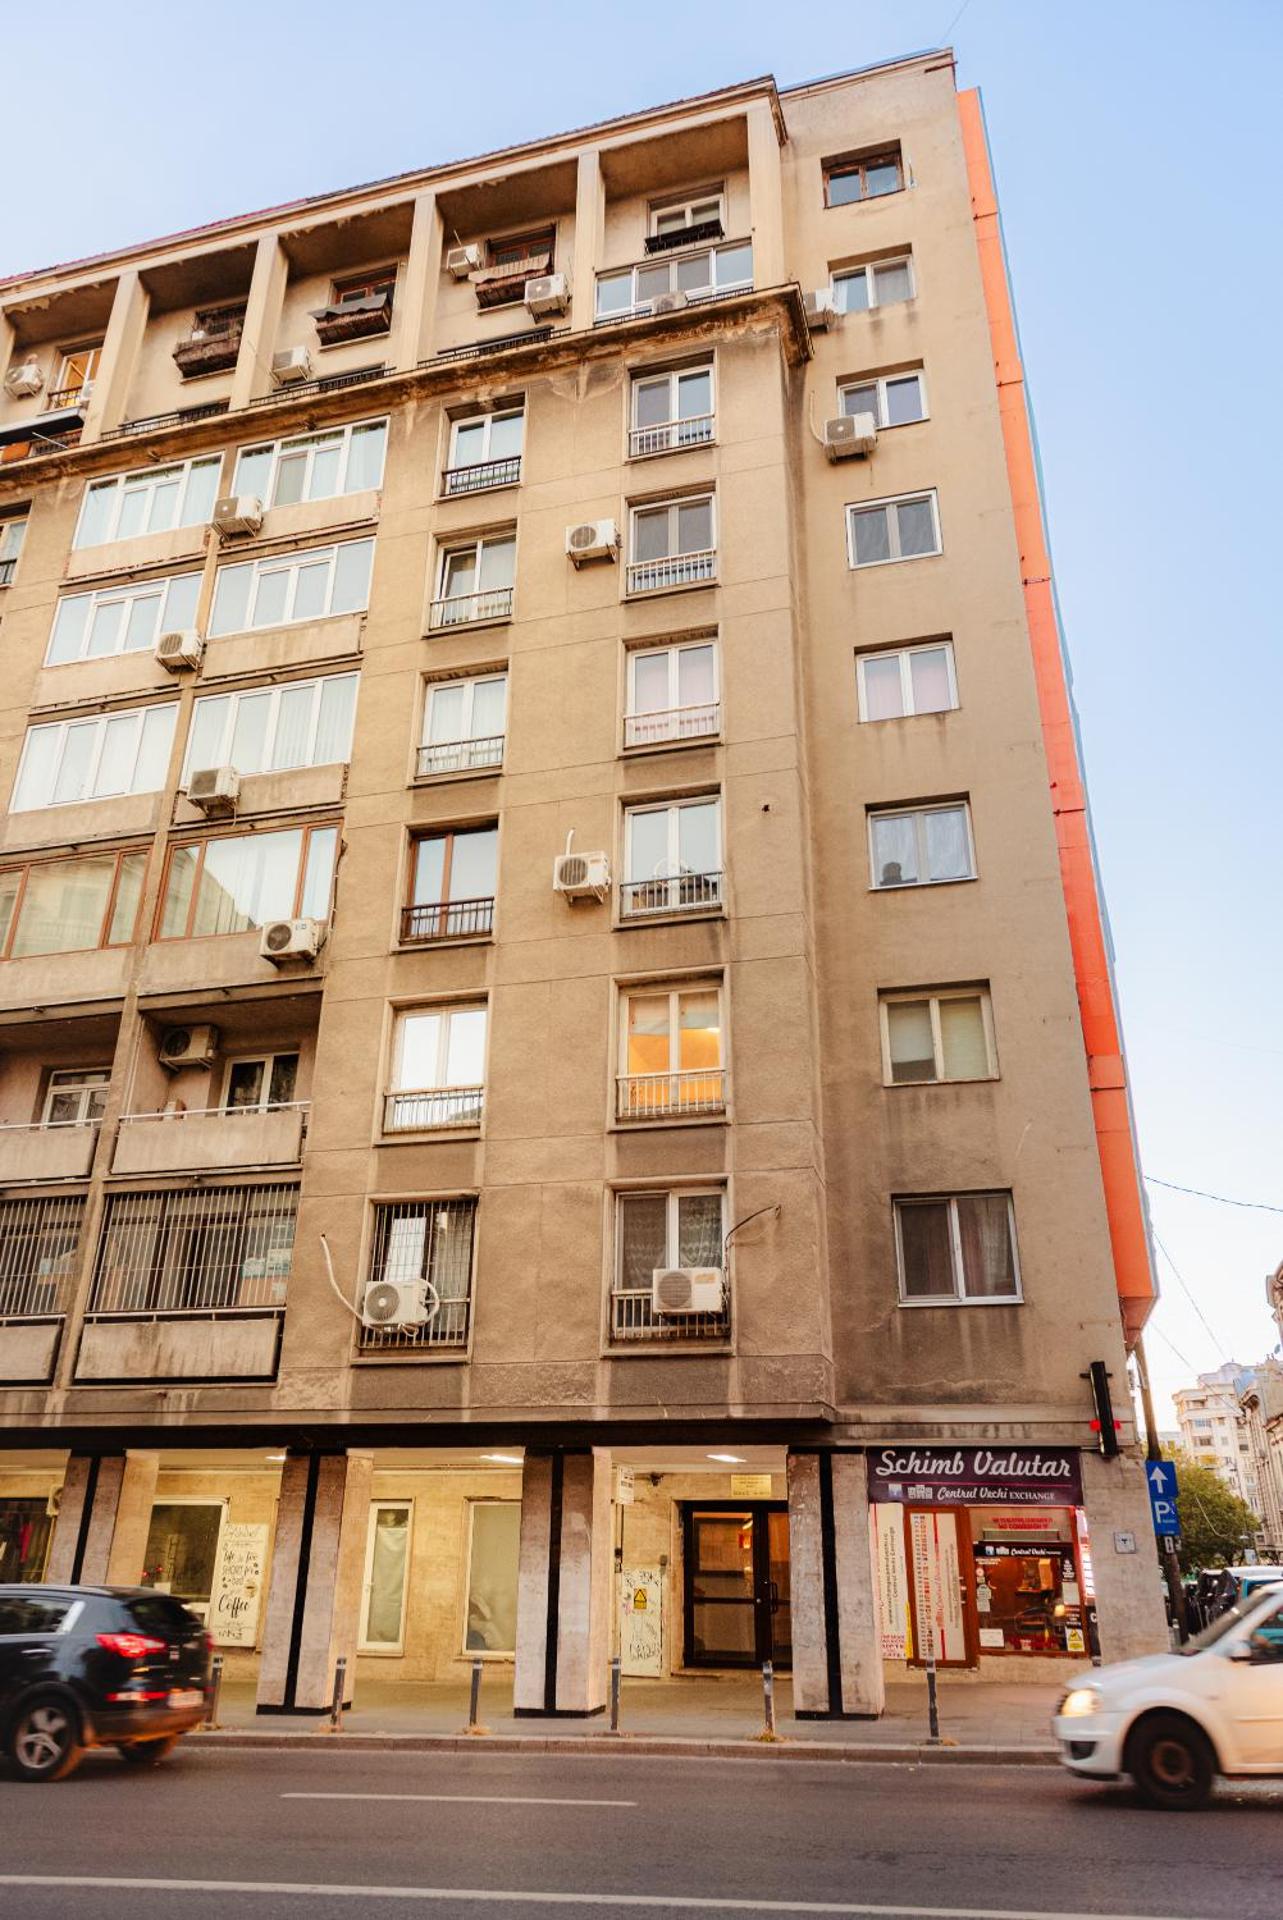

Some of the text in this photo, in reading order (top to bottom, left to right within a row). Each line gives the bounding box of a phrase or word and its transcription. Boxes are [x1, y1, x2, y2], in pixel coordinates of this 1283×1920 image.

[876, 1450, 1071, 1477] Schimb Valutar
[1009, 1492, 1055, 1500] EXCHANGE
[1154, 1501, 1170, 1524] P
[218, 1594, 248, 1618] Coffee
